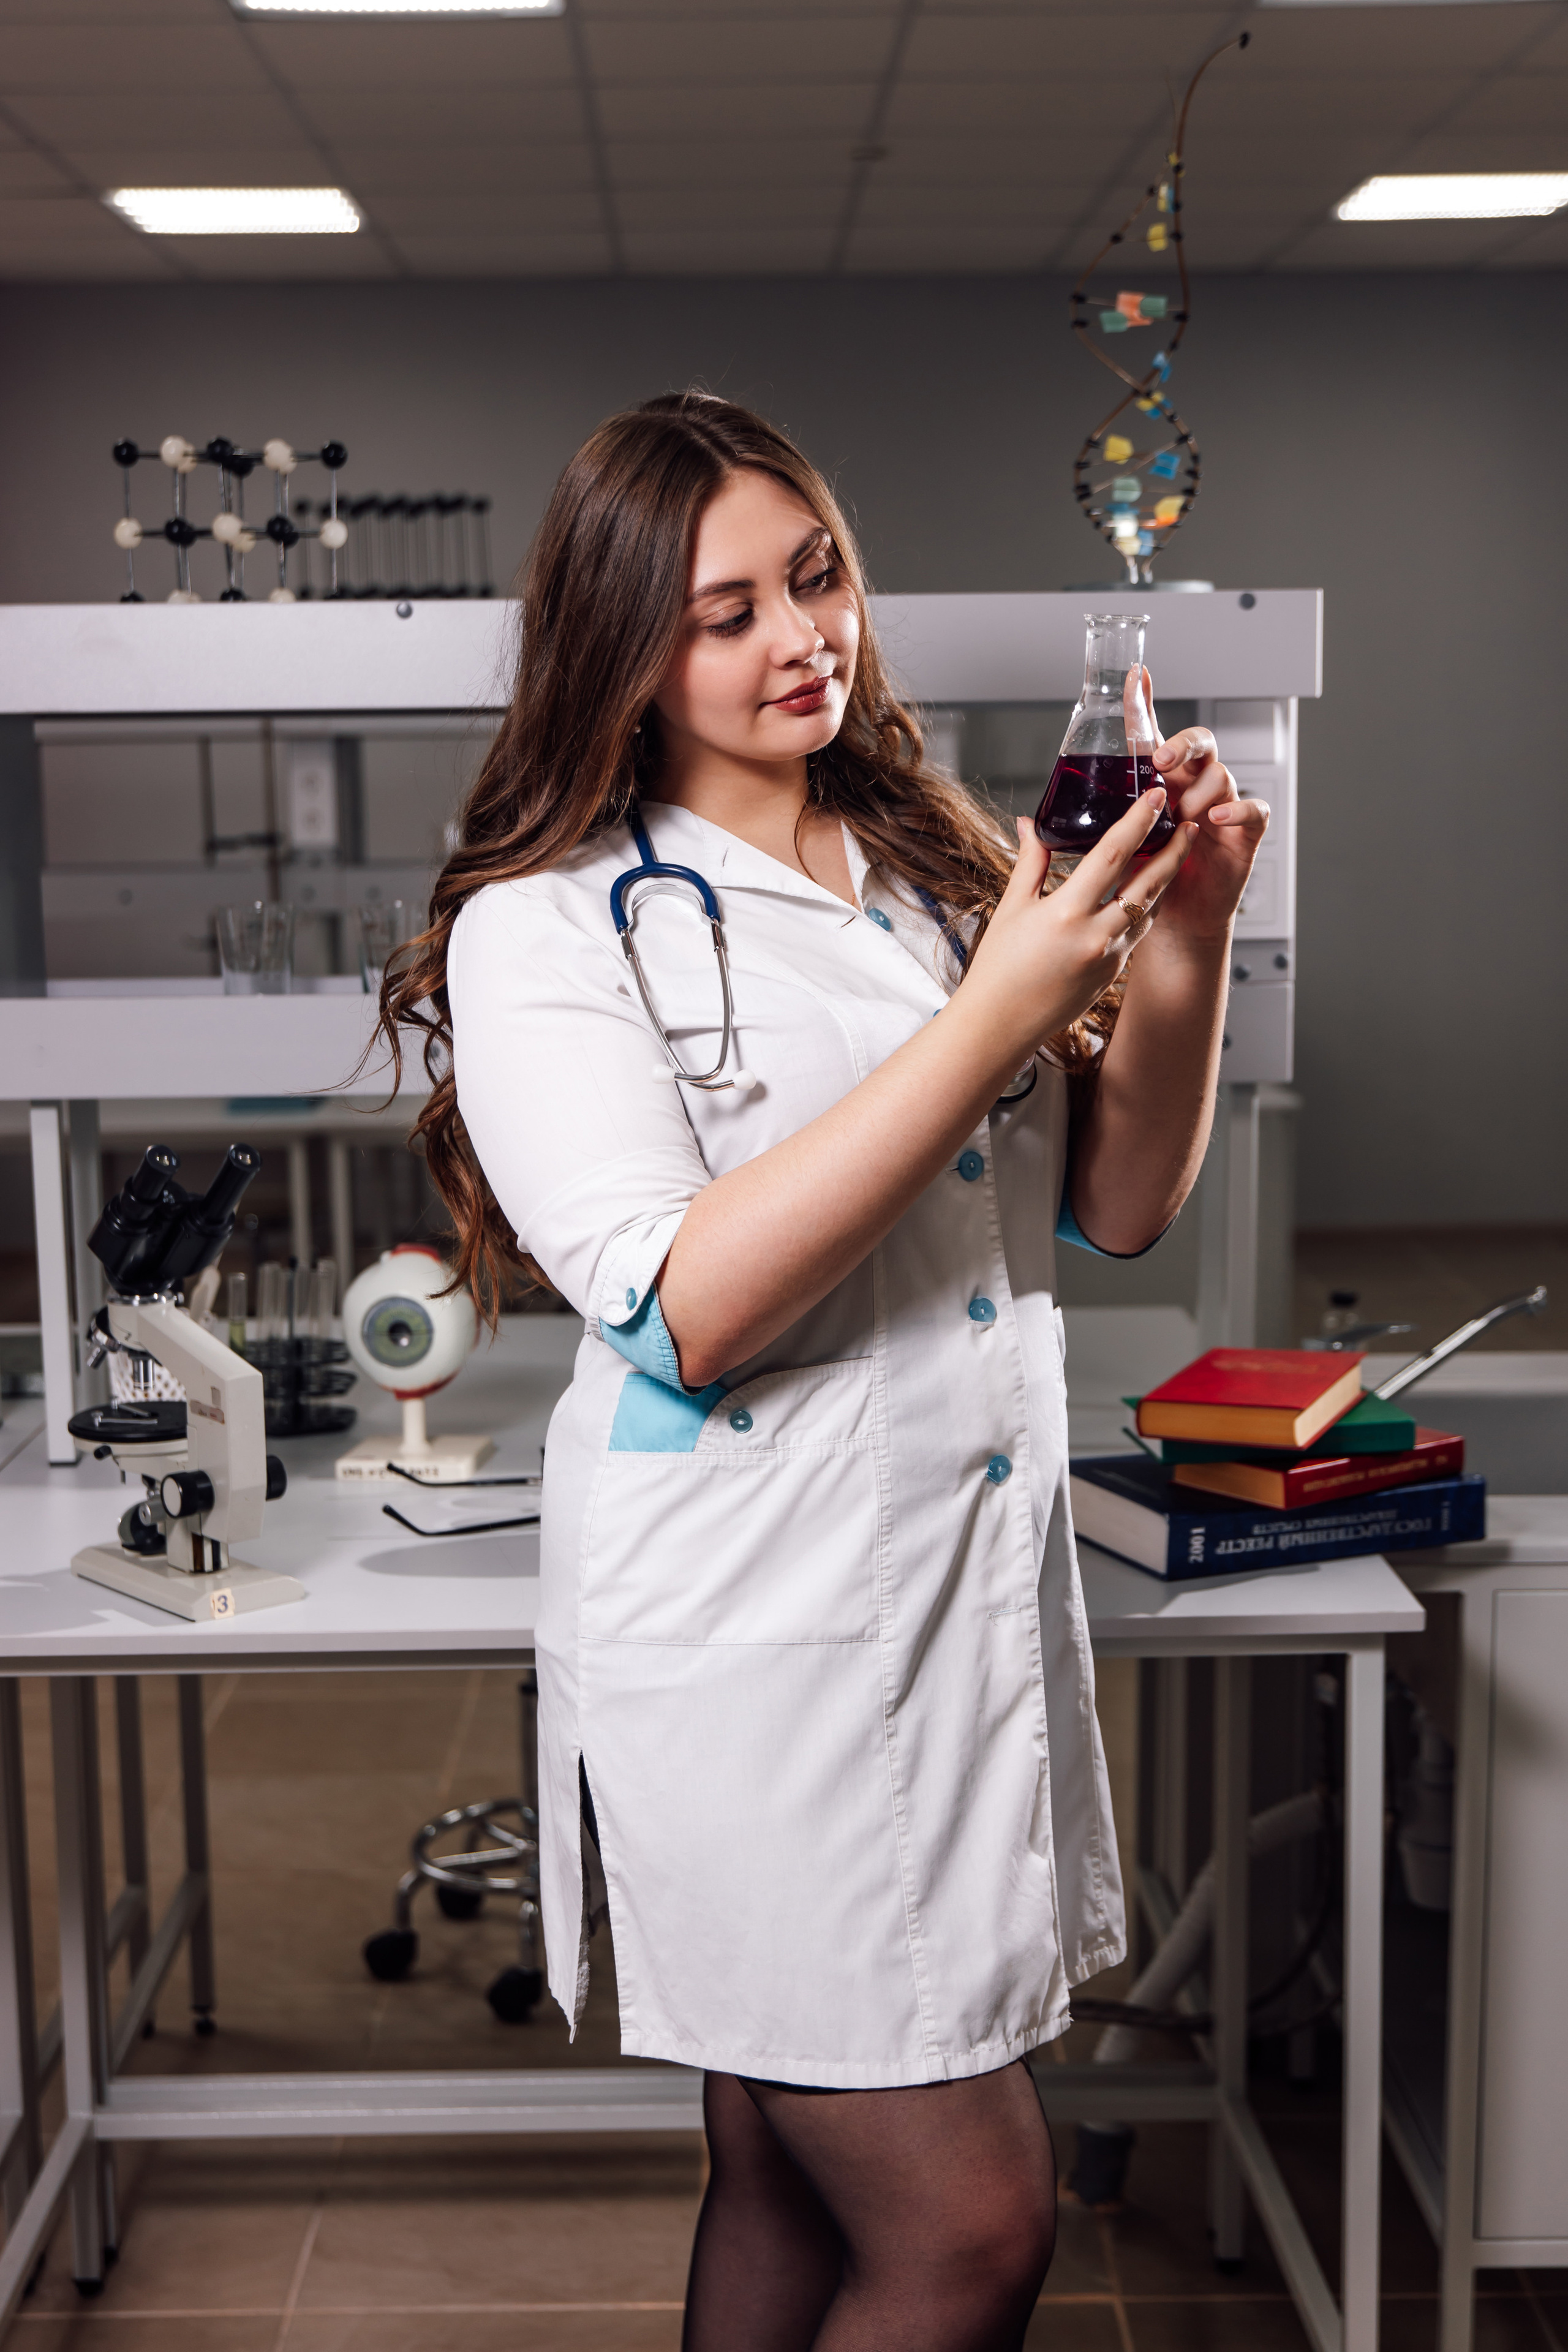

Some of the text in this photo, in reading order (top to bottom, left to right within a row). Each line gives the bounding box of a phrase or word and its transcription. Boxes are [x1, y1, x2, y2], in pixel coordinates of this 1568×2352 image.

[1140, 765, 1155, 775] 200
[1189, 1526, 1205, 1564] 2001
[217, 1594, 228, 1613] 3
